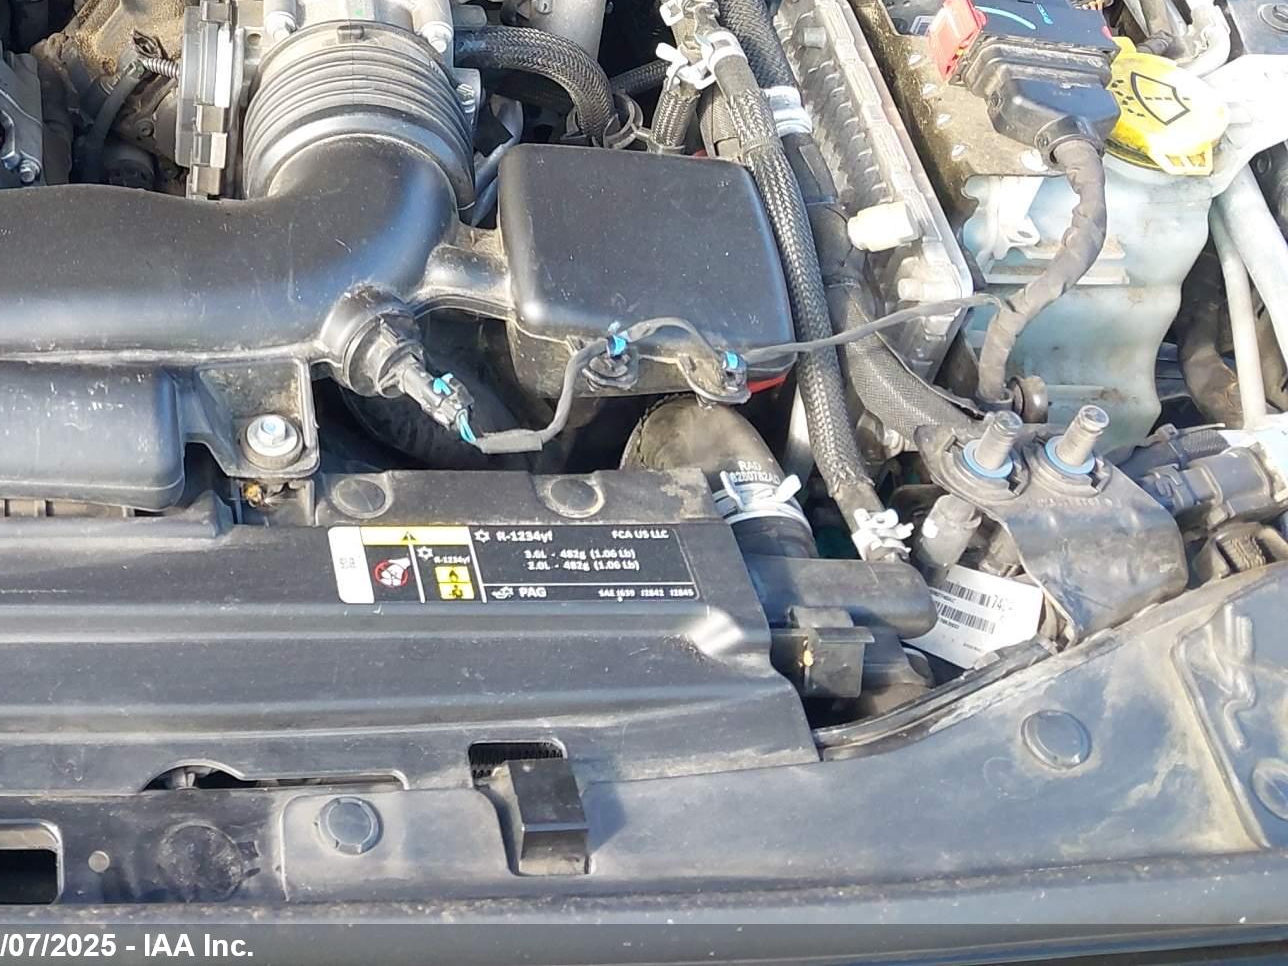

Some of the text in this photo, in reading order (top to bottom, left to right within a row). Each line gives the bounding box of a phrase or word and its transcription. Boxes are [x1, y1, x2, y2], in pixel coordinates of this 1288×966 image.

[495, 530, 553, 543] R-1234yf
[611, 529, 670, 539] FCA US LLC
[519, 586, 547, 598] PAG
